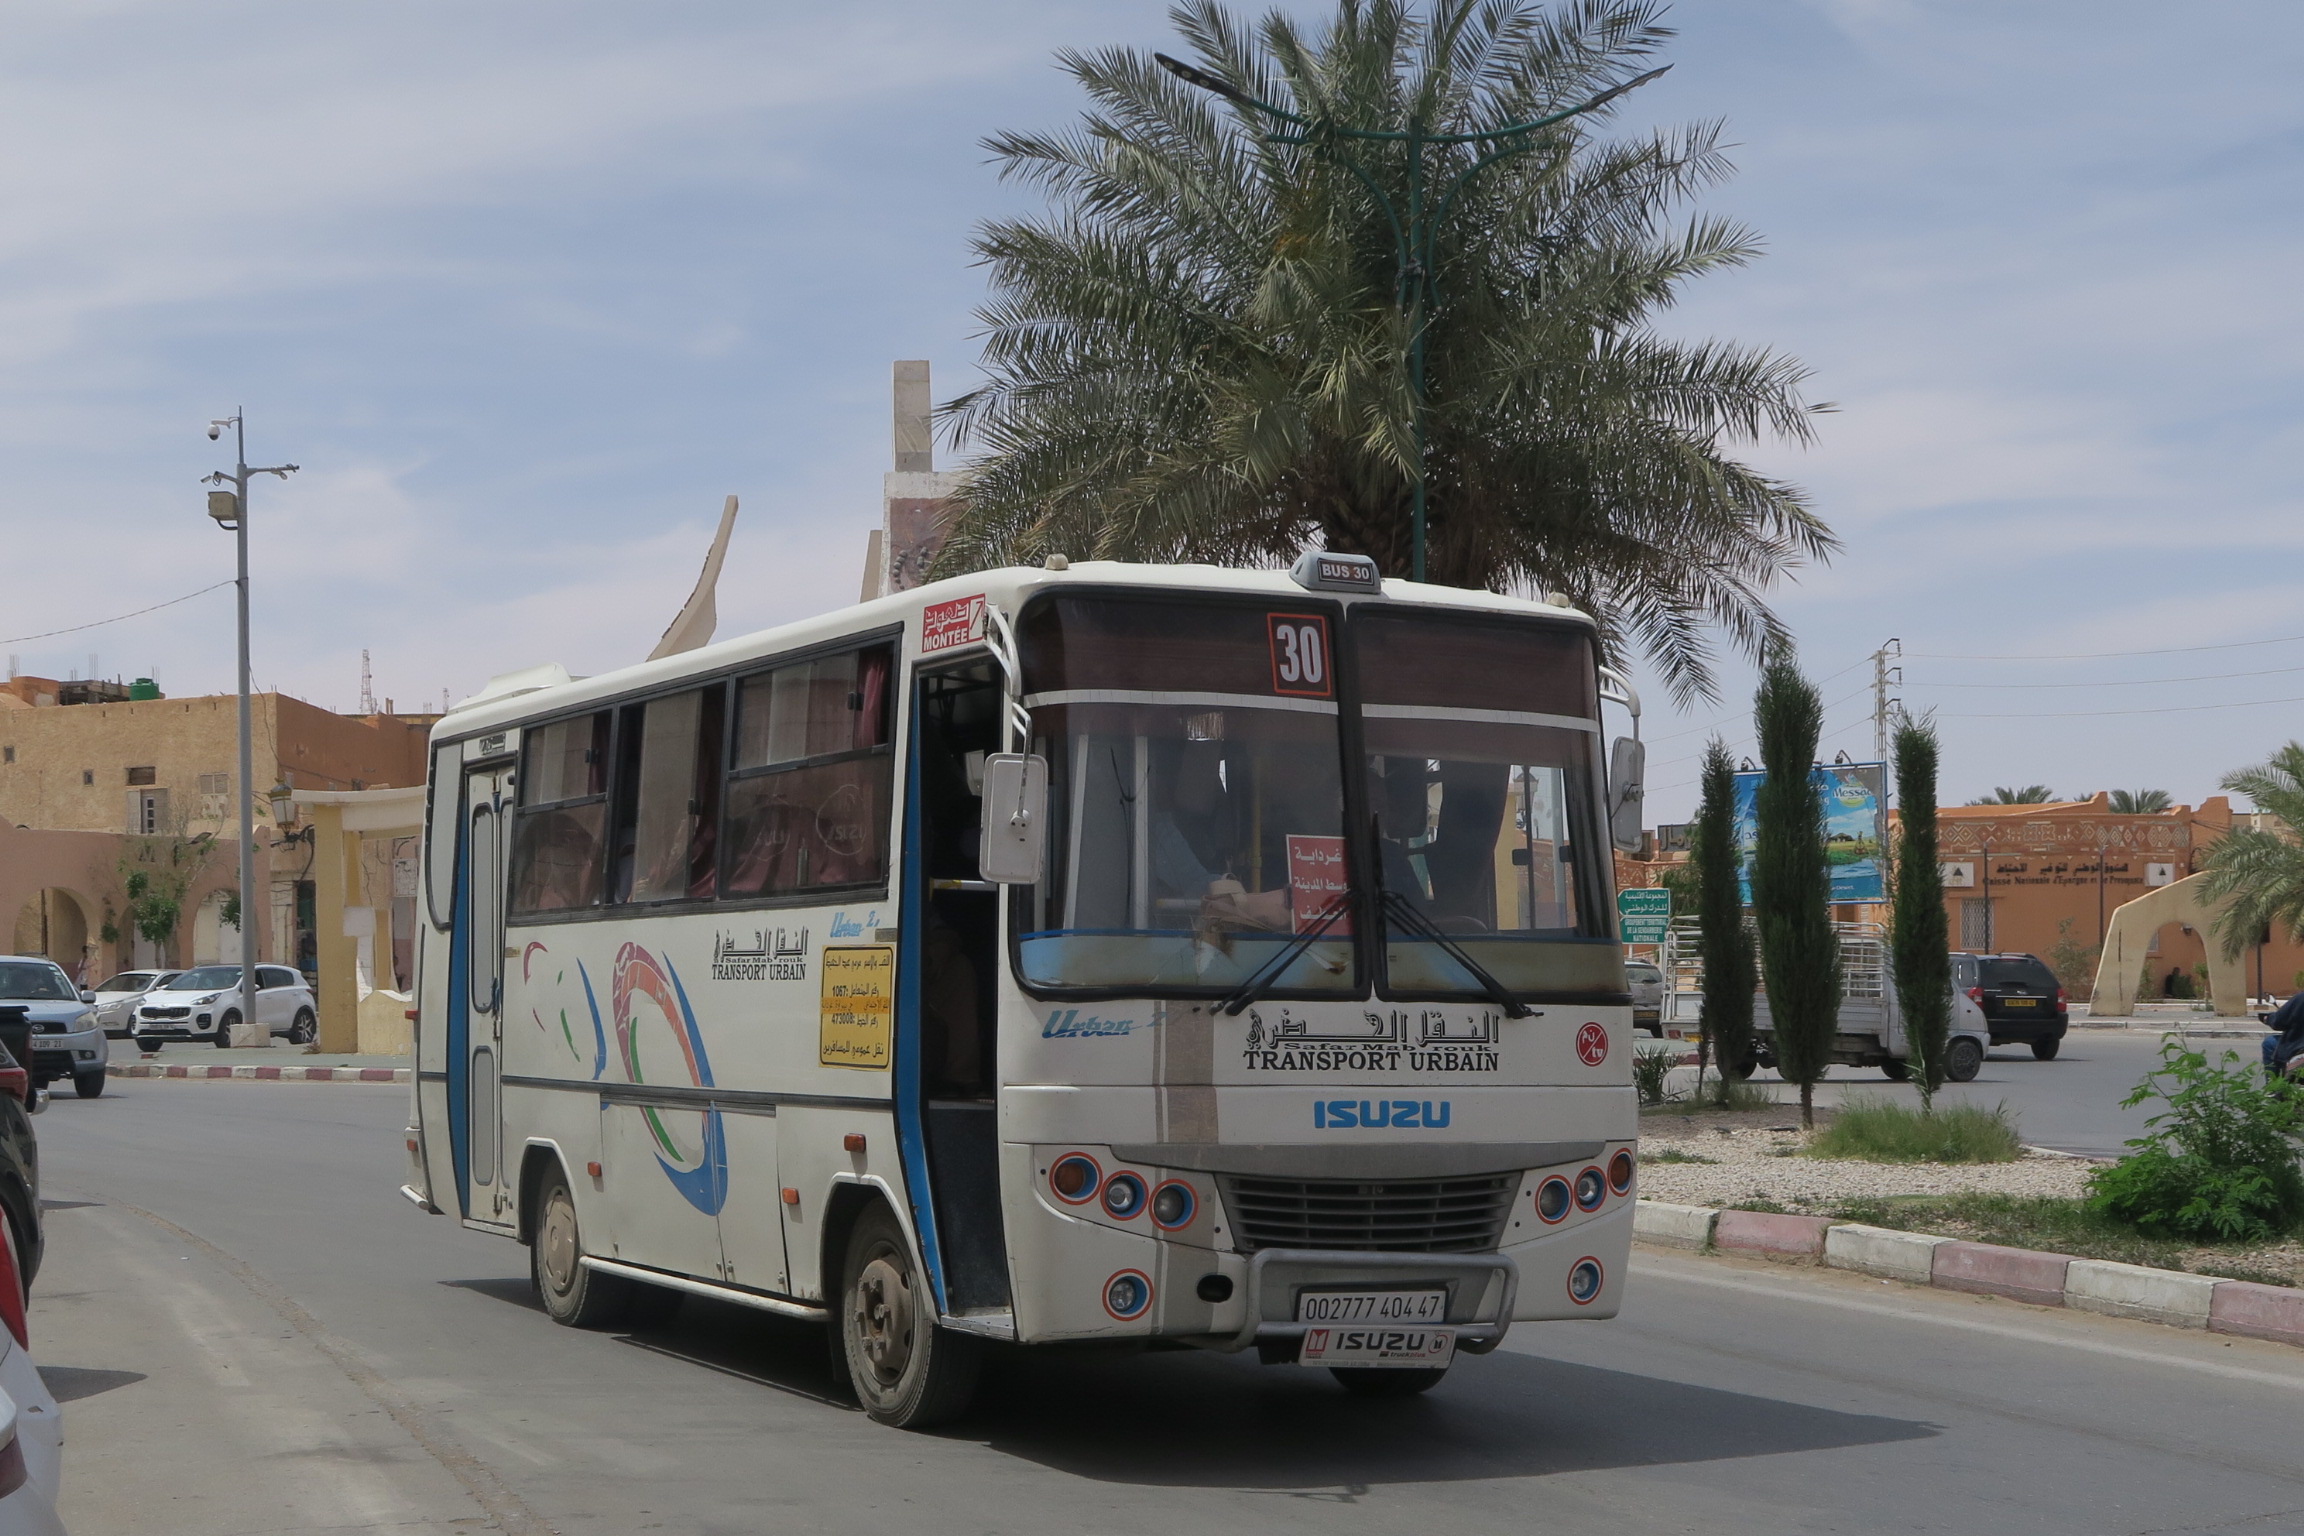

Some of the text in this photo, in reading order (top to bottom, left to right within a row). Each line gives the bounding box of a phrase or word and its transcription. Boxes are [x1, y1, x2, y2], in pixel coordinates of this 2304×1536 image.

[1322, 563, 1370, 580] BUS 30
[923, 626, 968, 651] MONTÉE
[1276, 624, 1322, 683] 30
[1294, 846, 1342, 865] غرداية
[1294, 876, 1351, 894] وسط المدينة
[830, 912, 864, 938] Urban
[713, 925, 809, 963] النقل الحضري
[711, 963, 807, 981] TRANSPORT URBAIN
[1041, 1009, 1139, 1039] Urban
[1245, 1008, 1501, 1050] النقل الحضري
[1284, 1042, 1357, 1051] Safar
[1243, 1050, 1500, 1072] TRANSPORT URBAIN
[1313, 1100, 1451, 1129] ISUZU
[1305, 1296, 1440, 1320] 002777 404 47
[1336, 1332, 1425, 1350] ISUZU
